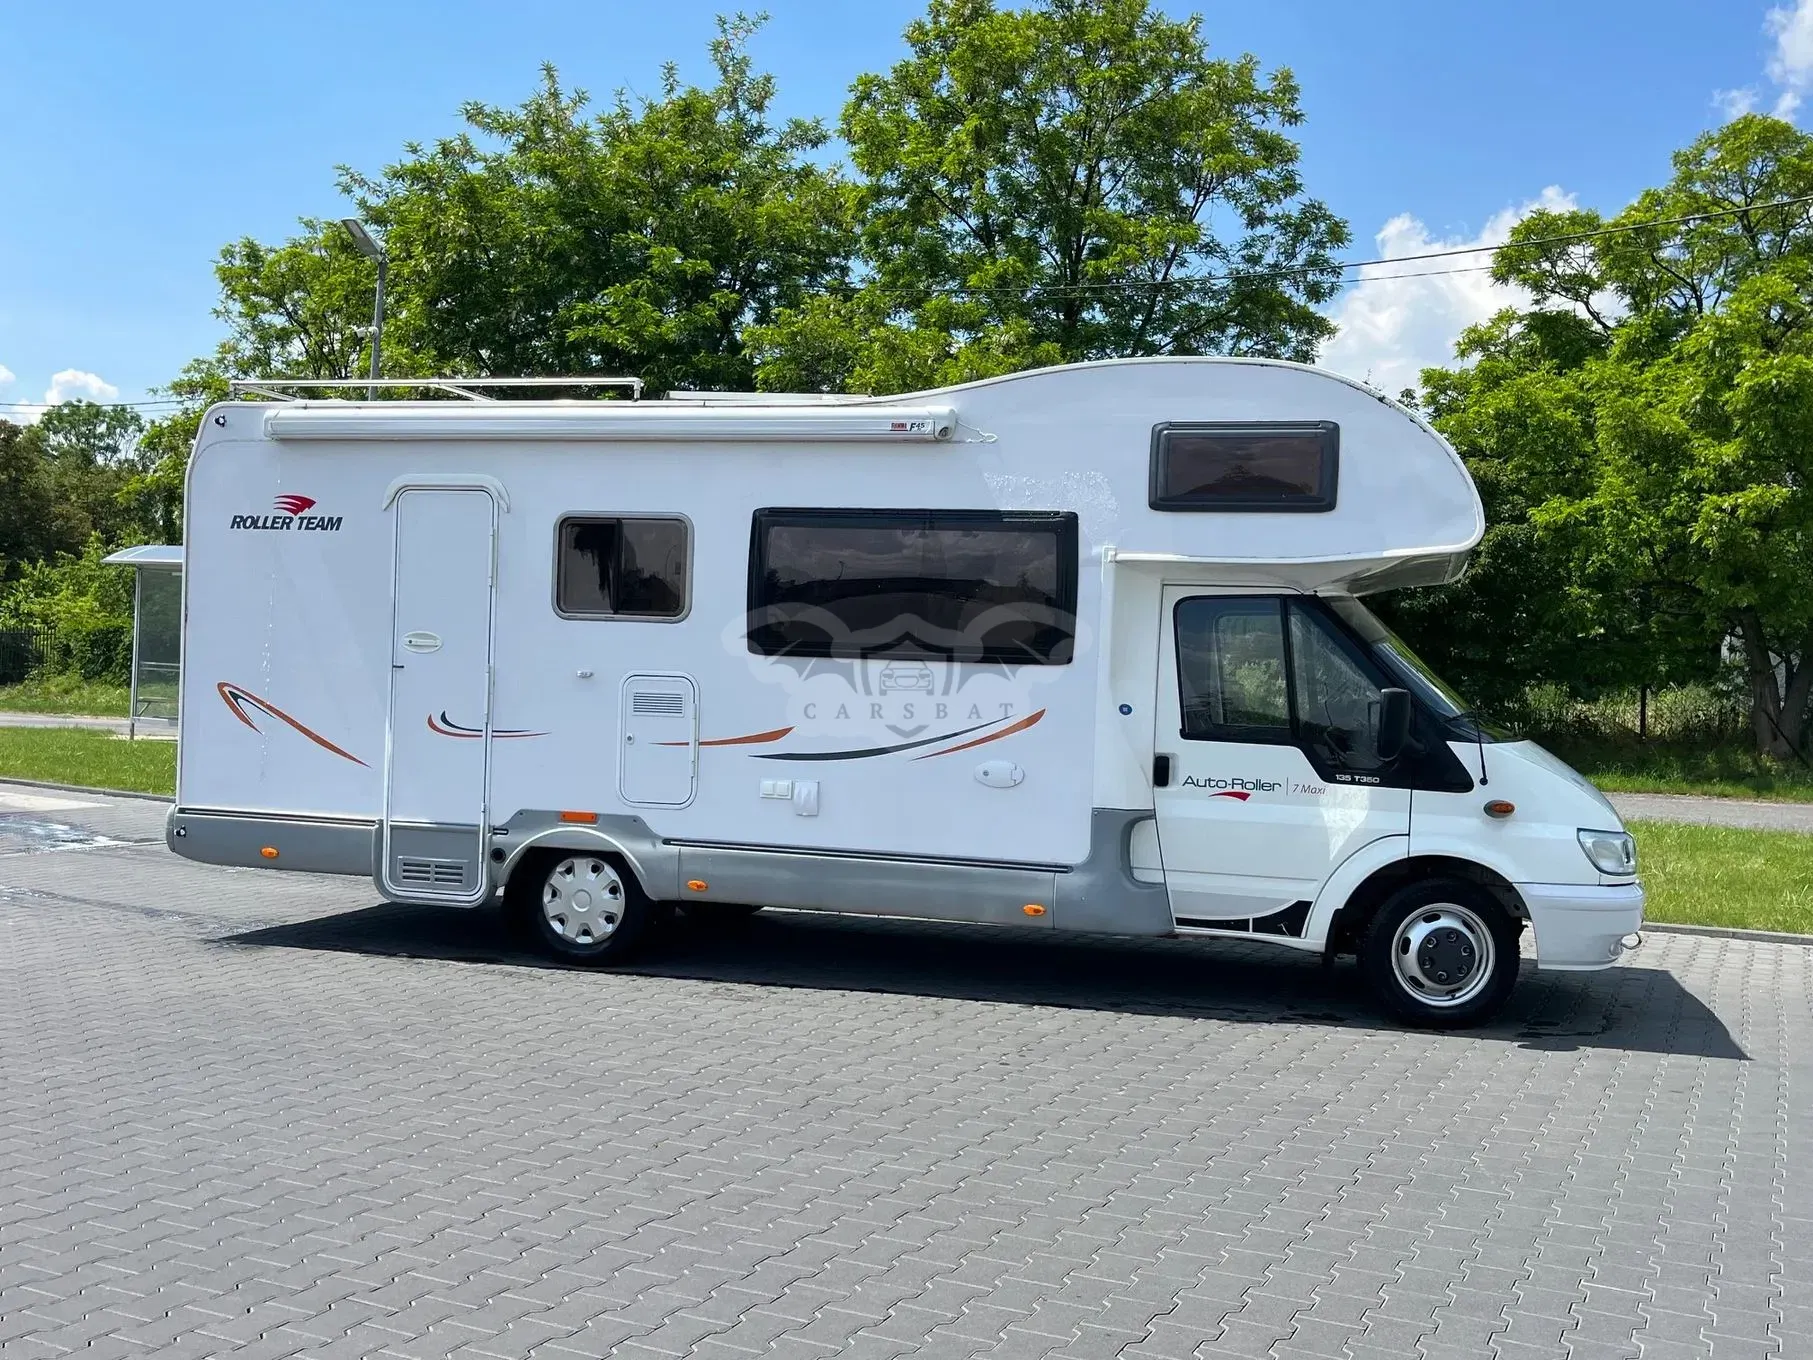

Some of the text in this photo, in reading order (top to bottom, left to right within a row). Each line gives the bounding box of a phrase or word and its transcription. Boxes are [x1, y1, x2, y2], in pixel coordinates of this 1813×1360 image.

[230, 515, 343, 531] ROLLER TEAM
[1182, 775, 1326, 795] Auto-Roller 7 Maxi
[1354, 775, 1380, 783] T350
